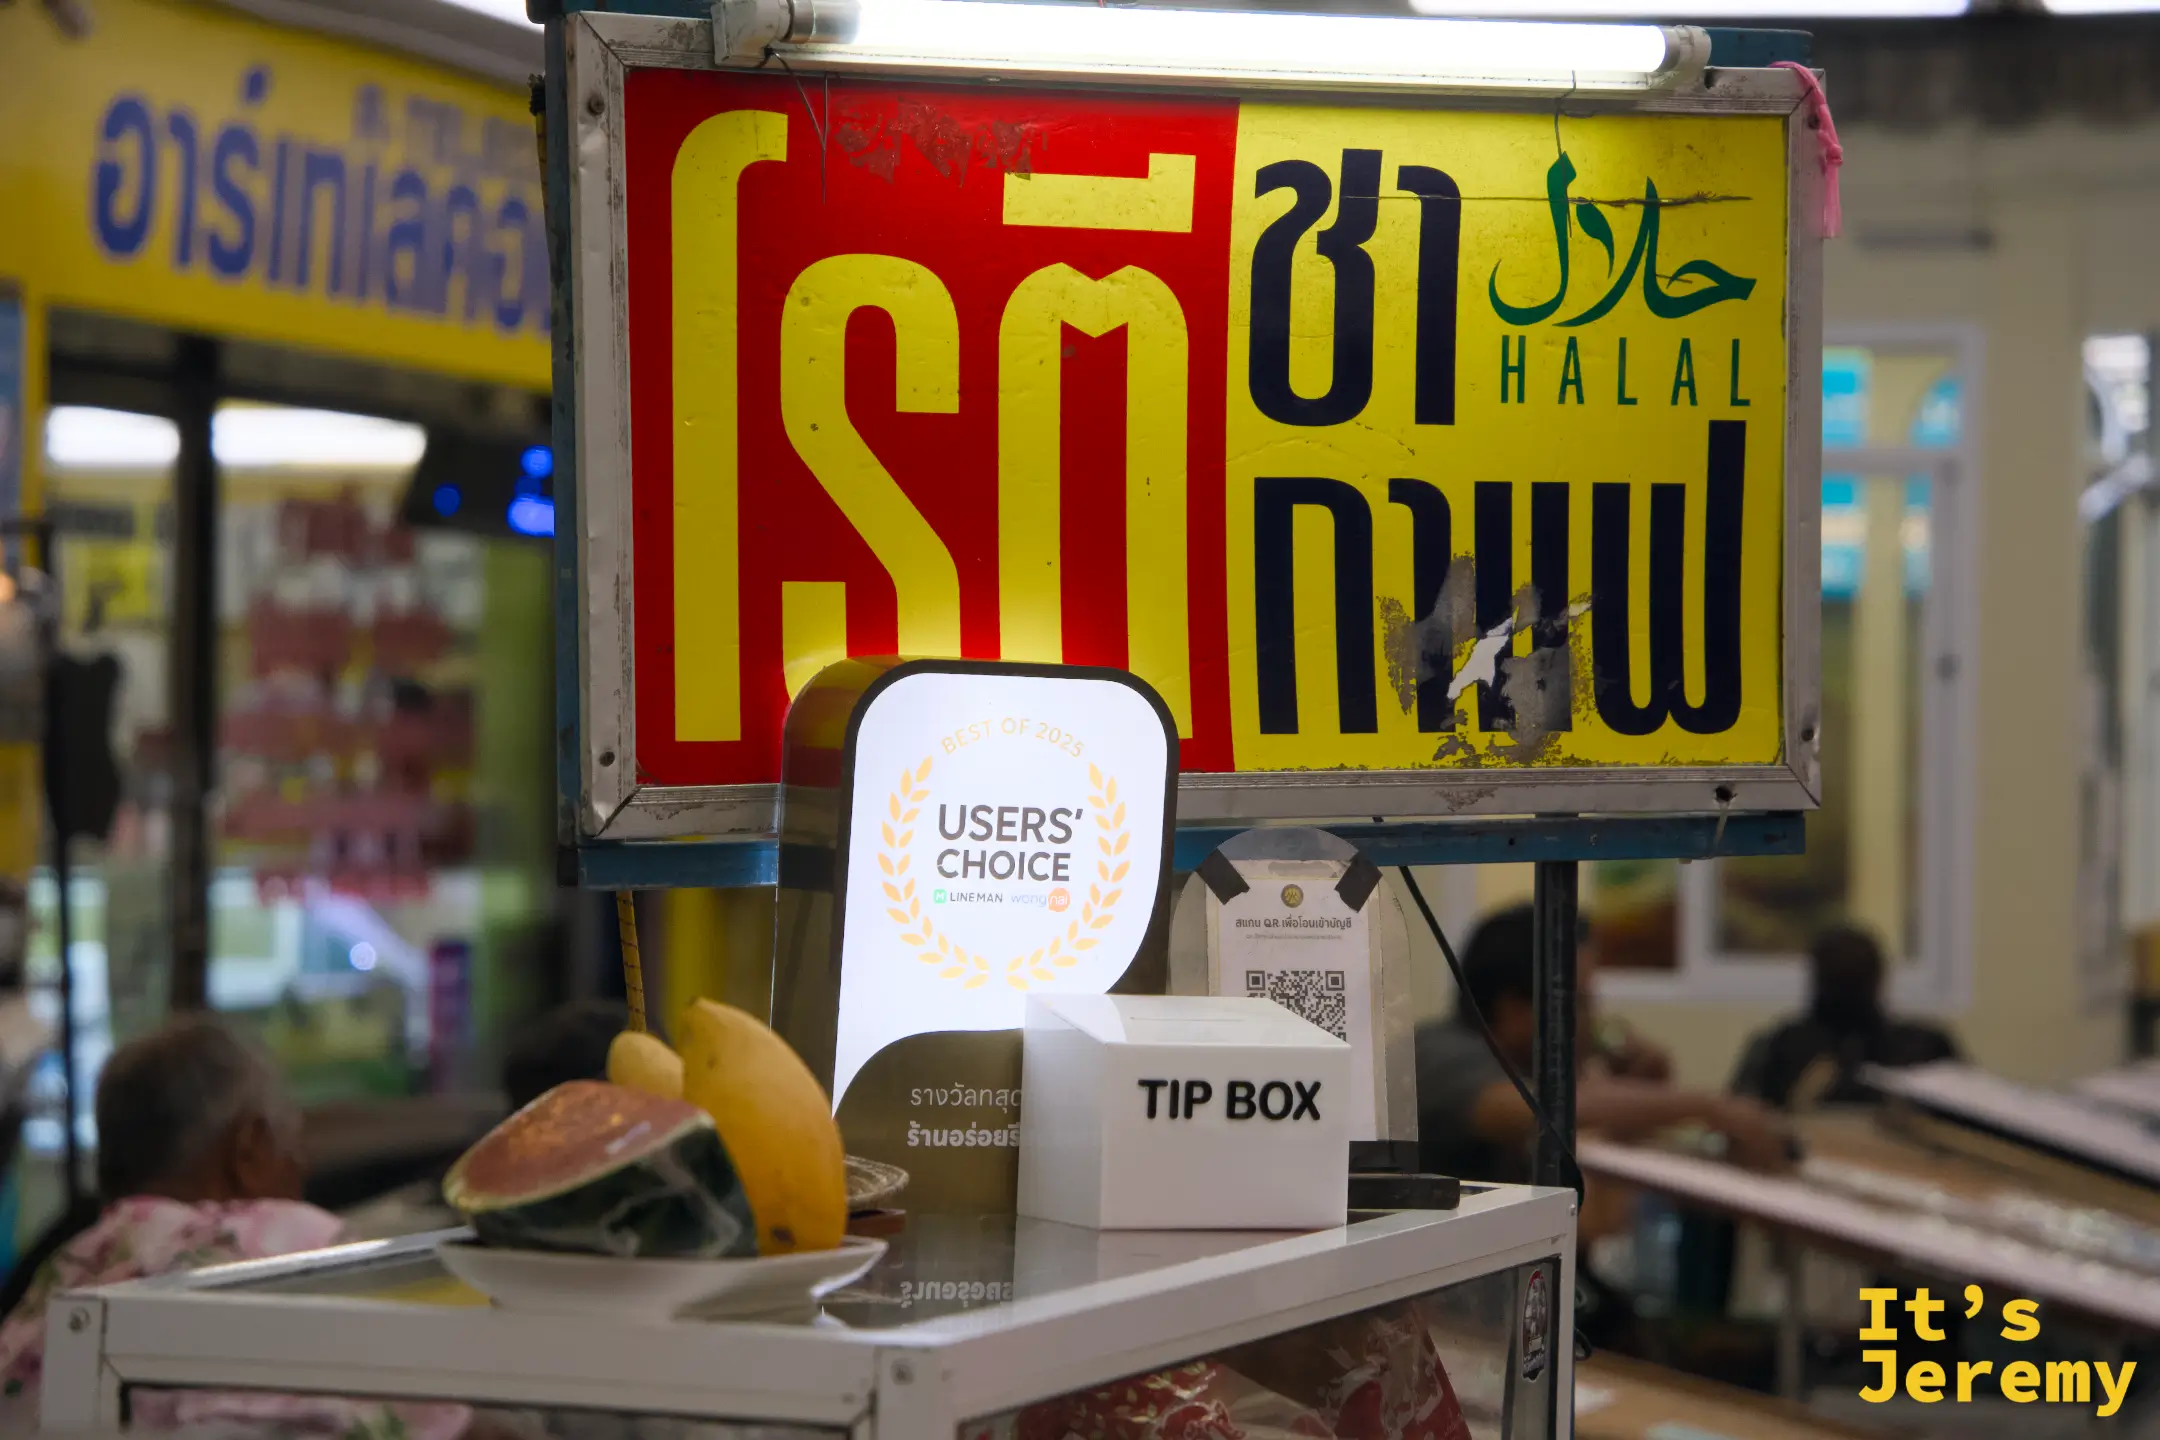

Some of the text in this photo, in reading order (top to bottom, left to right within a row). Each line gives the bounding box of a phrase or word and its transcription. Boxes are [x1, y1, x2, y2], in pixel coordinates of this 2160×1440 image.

[92, 64, 551, 338] อาร์เทเลคอ
[1488, 151, 1757, 327] حلال
[1248, 149, 1462, 425] ชา
[671, 109, 1196, 742] โรตี
[1500, 335, 1751, 407] HALAL
[1254, 420, 1747, 736] กาแฟ
[941, 717, 1085, 758] BEST OF 2025
[936, 849, 1071, 882] CHOICE
[1264, 918, 1279, 928] QR
[1138, 1078, 1322, 1121] TIP BOX
